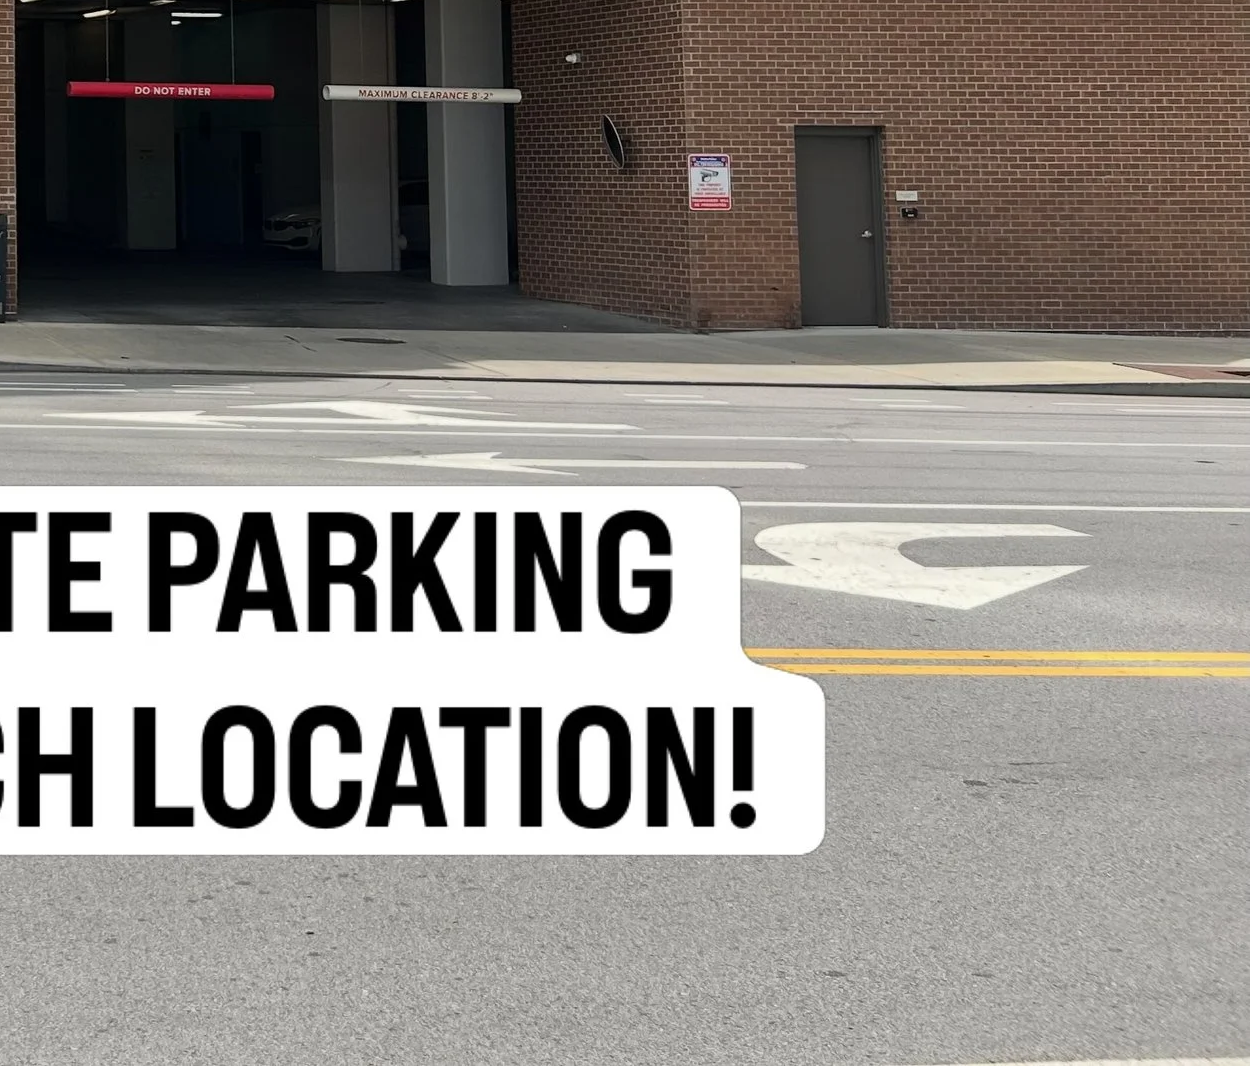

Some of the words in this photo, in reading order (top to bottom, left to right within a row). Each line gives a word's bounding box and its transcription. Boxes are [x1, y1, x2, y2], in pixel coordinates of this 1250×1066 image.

[134, 86, 150, 95] DO
[153, 86, 175, 95] NOT
[178, 87, 211, 96] ENTER
[358, 89, 408, 98] MAXIMUM
[411, 90, 469, 100] CLEARANCE
